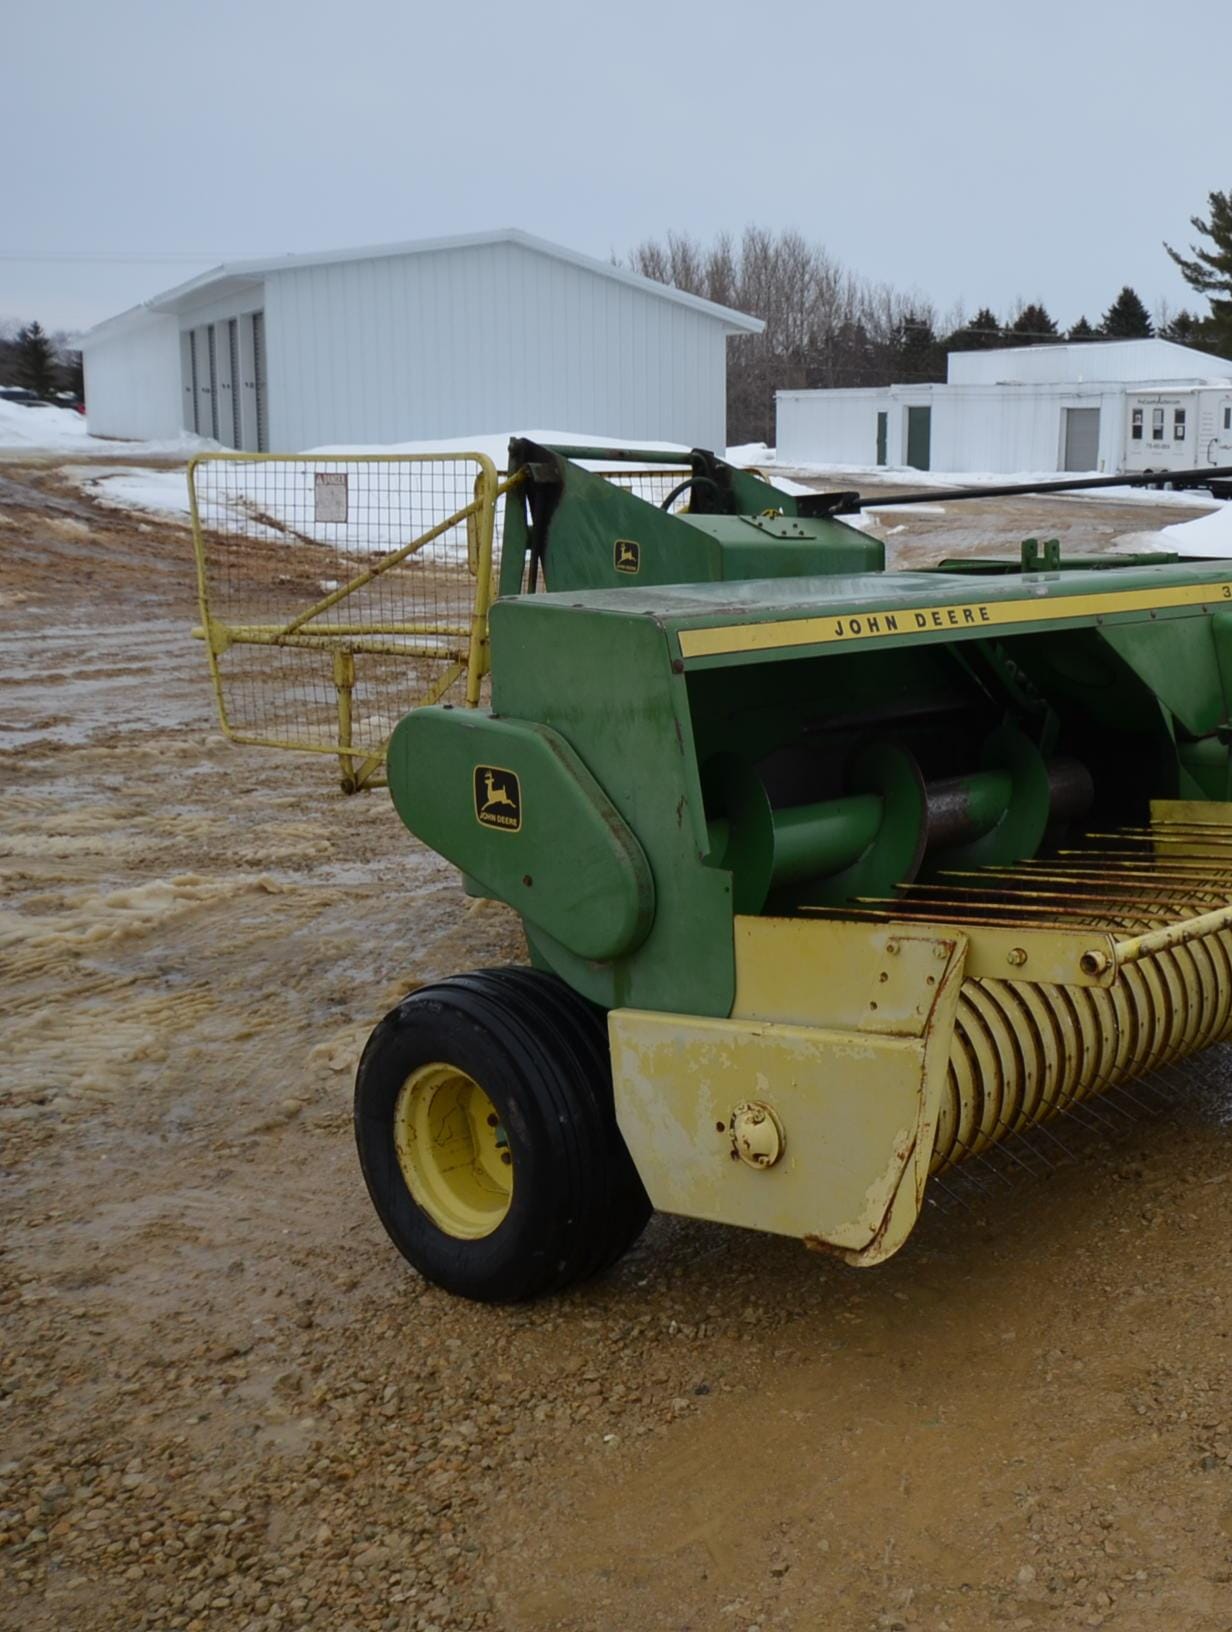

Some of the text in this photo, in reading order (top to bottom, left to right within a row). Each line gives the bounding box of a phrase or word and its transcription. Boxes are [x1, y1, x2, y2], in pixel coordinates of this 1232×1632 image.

[834, 606, 990, 637] JOHN DEERE
[480, 811, 518, 827] JOHN DEERE
